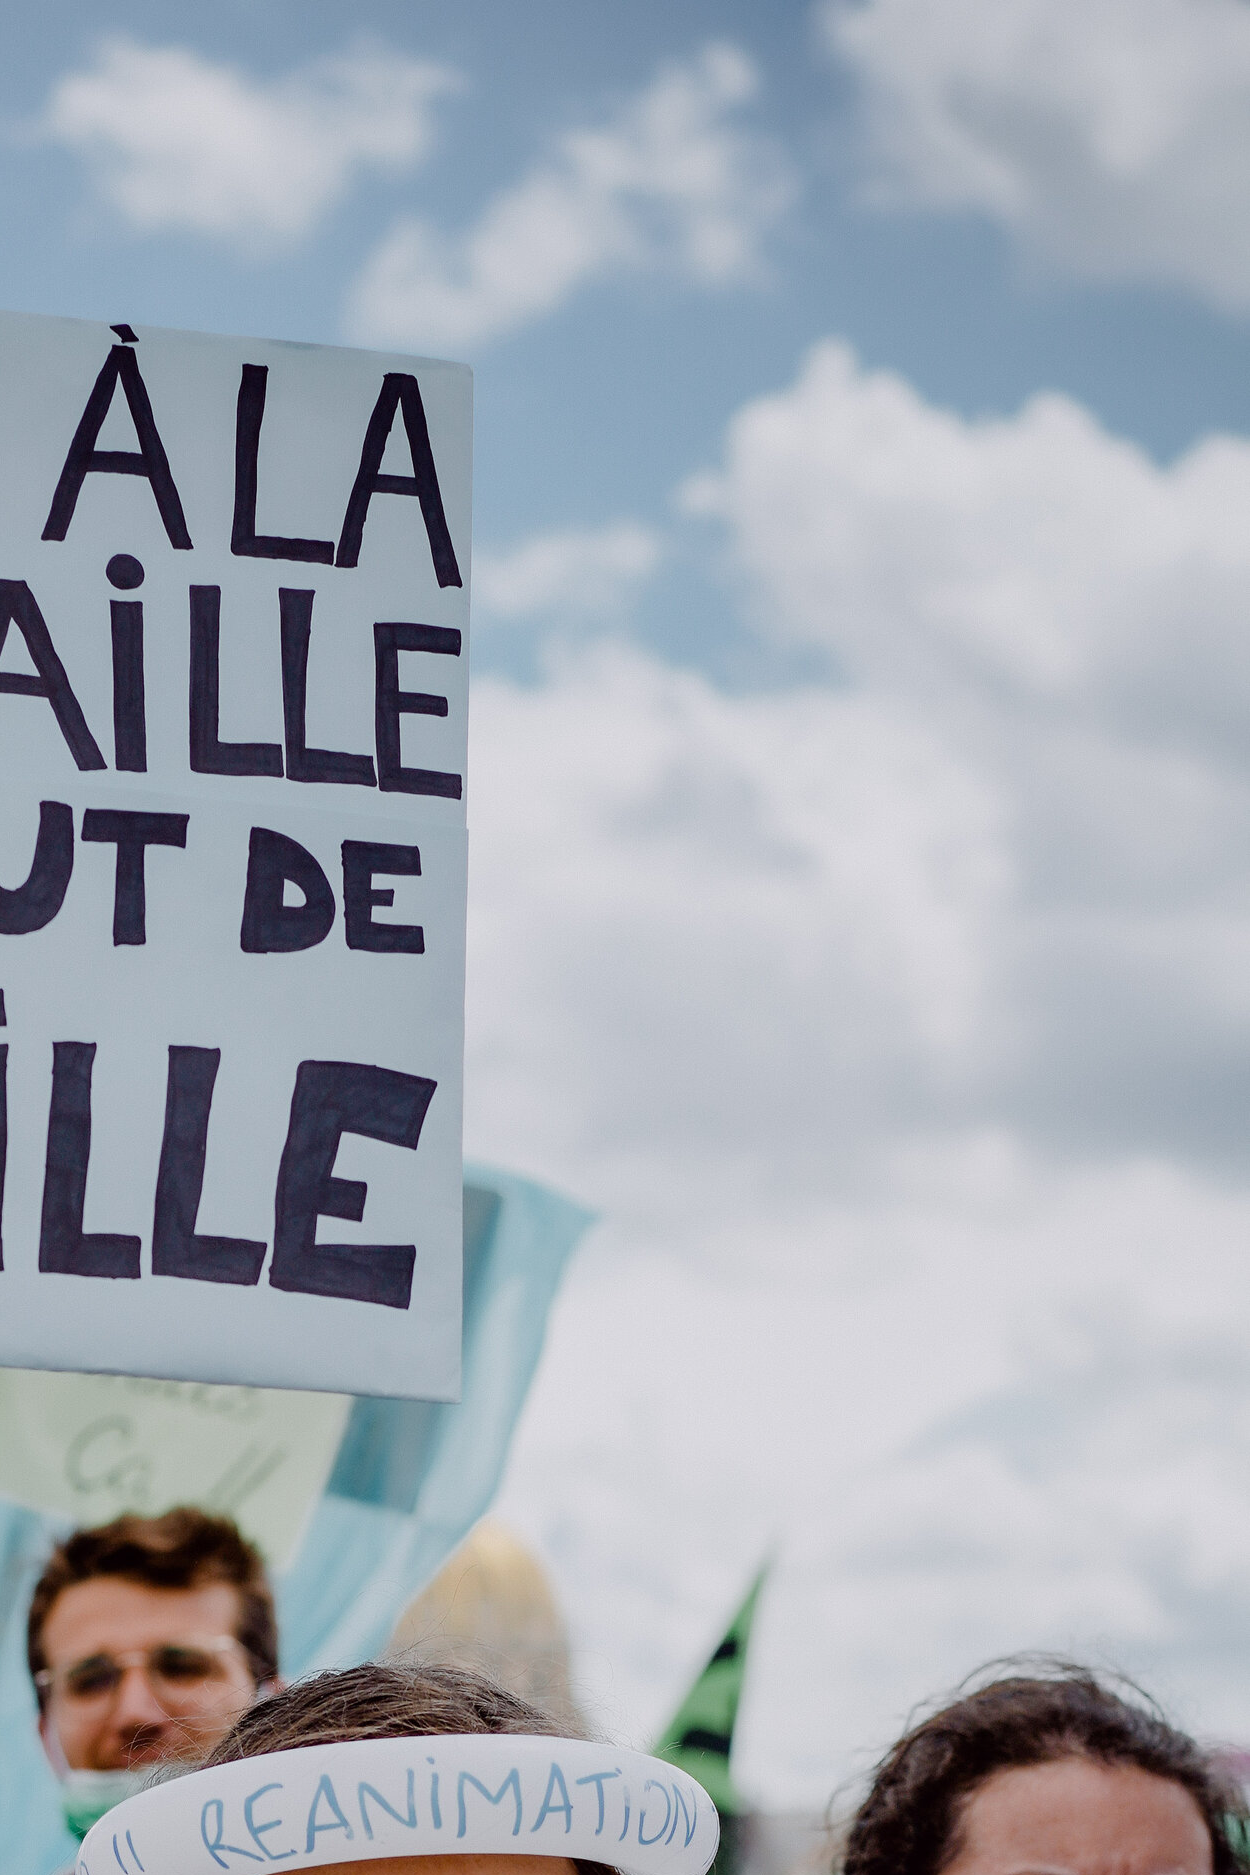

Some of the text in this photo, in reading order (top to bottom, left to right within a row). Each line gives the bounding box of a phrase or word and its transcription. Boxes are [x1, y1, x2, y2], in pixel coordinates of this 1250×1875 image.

[41, 323, 194, 550] À
[231, 363, 463, 589] LA
[240, 826, 425, 954] DE
